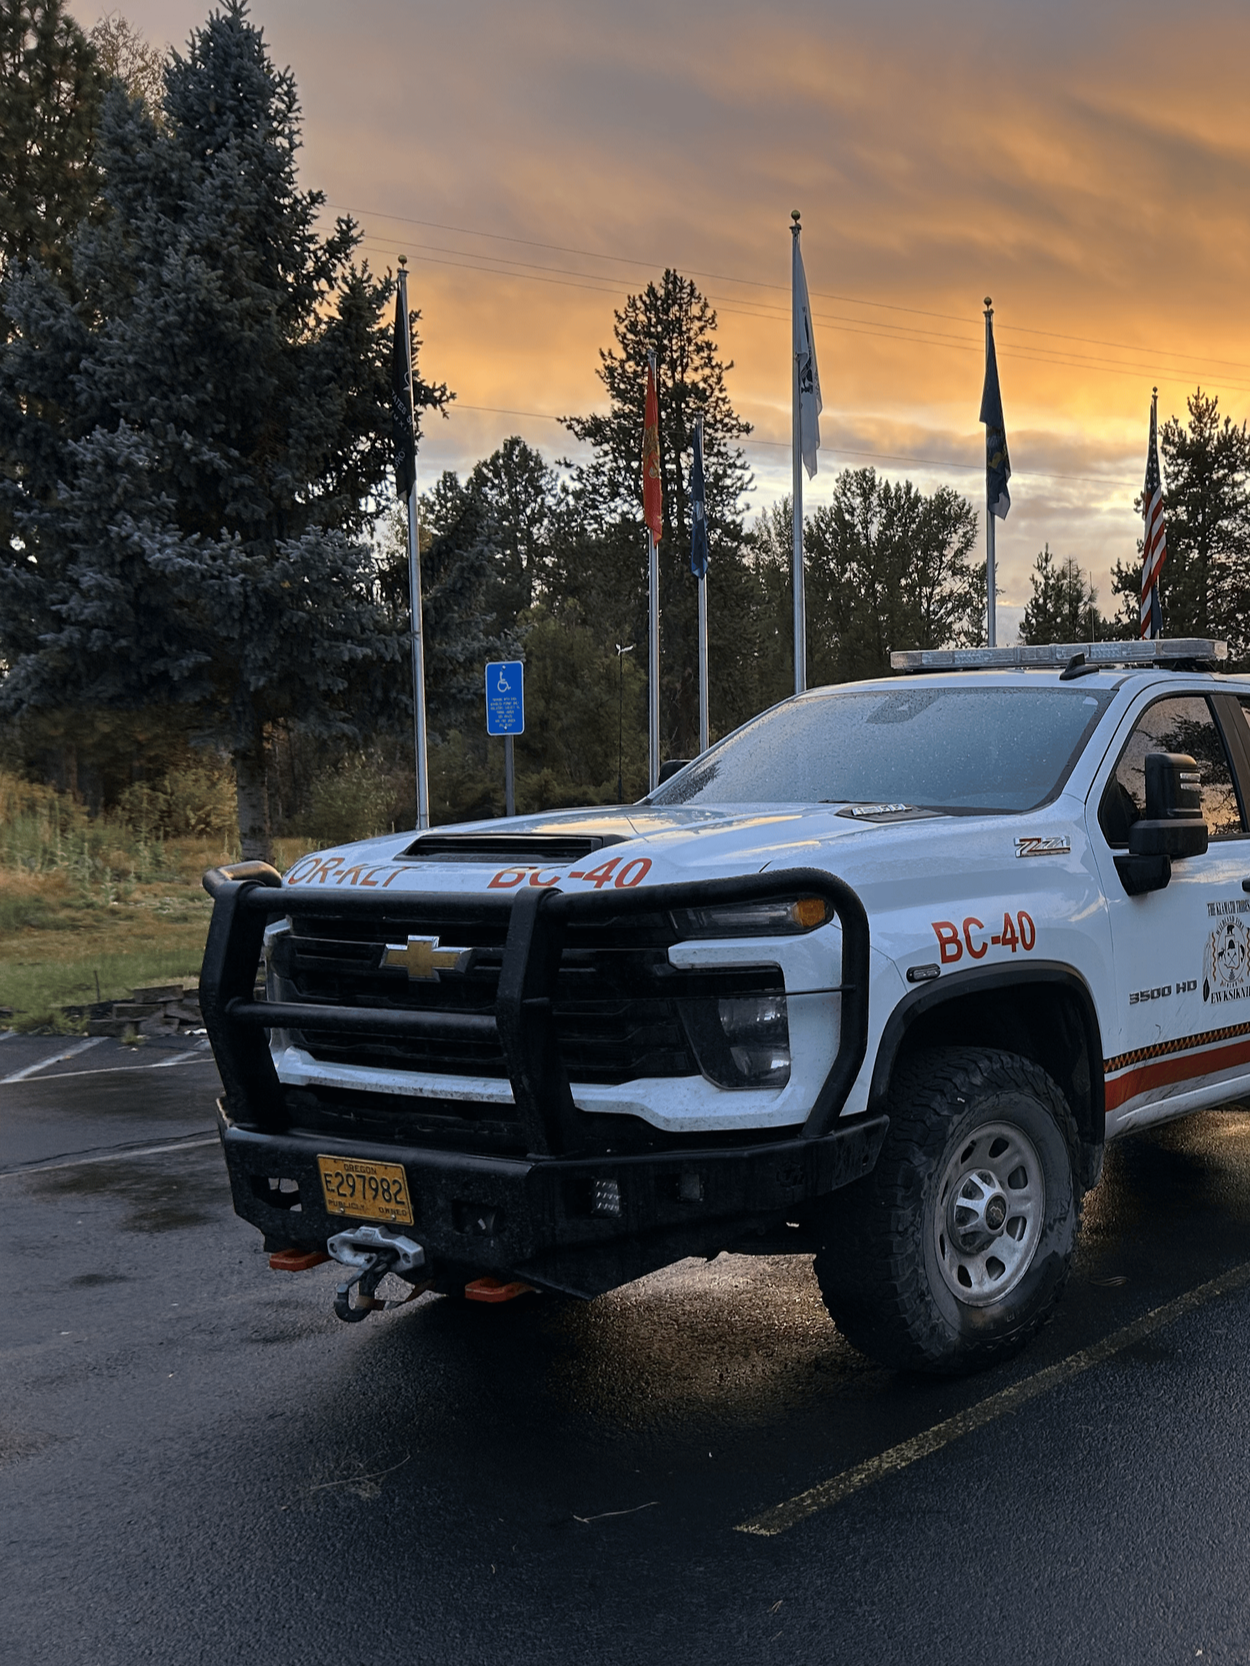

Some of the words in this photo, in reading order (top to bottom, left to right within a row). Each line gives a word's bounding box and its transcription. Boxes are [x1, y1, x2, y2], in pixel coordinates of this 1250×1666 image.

[1014, 835, 1071, 858] Z71
[487, 857, 653, 889] BC-40
[931, 910, 1036, 964] BC-40
[1129, 985, 1172, 1005] 3500
[1175, 979, 1198, 995] HD
[343, 1163, 377, 1175] OREGON
[323, 1171, 405, 1206] E297982
[378, 1206, 408, 1217] OWNED
